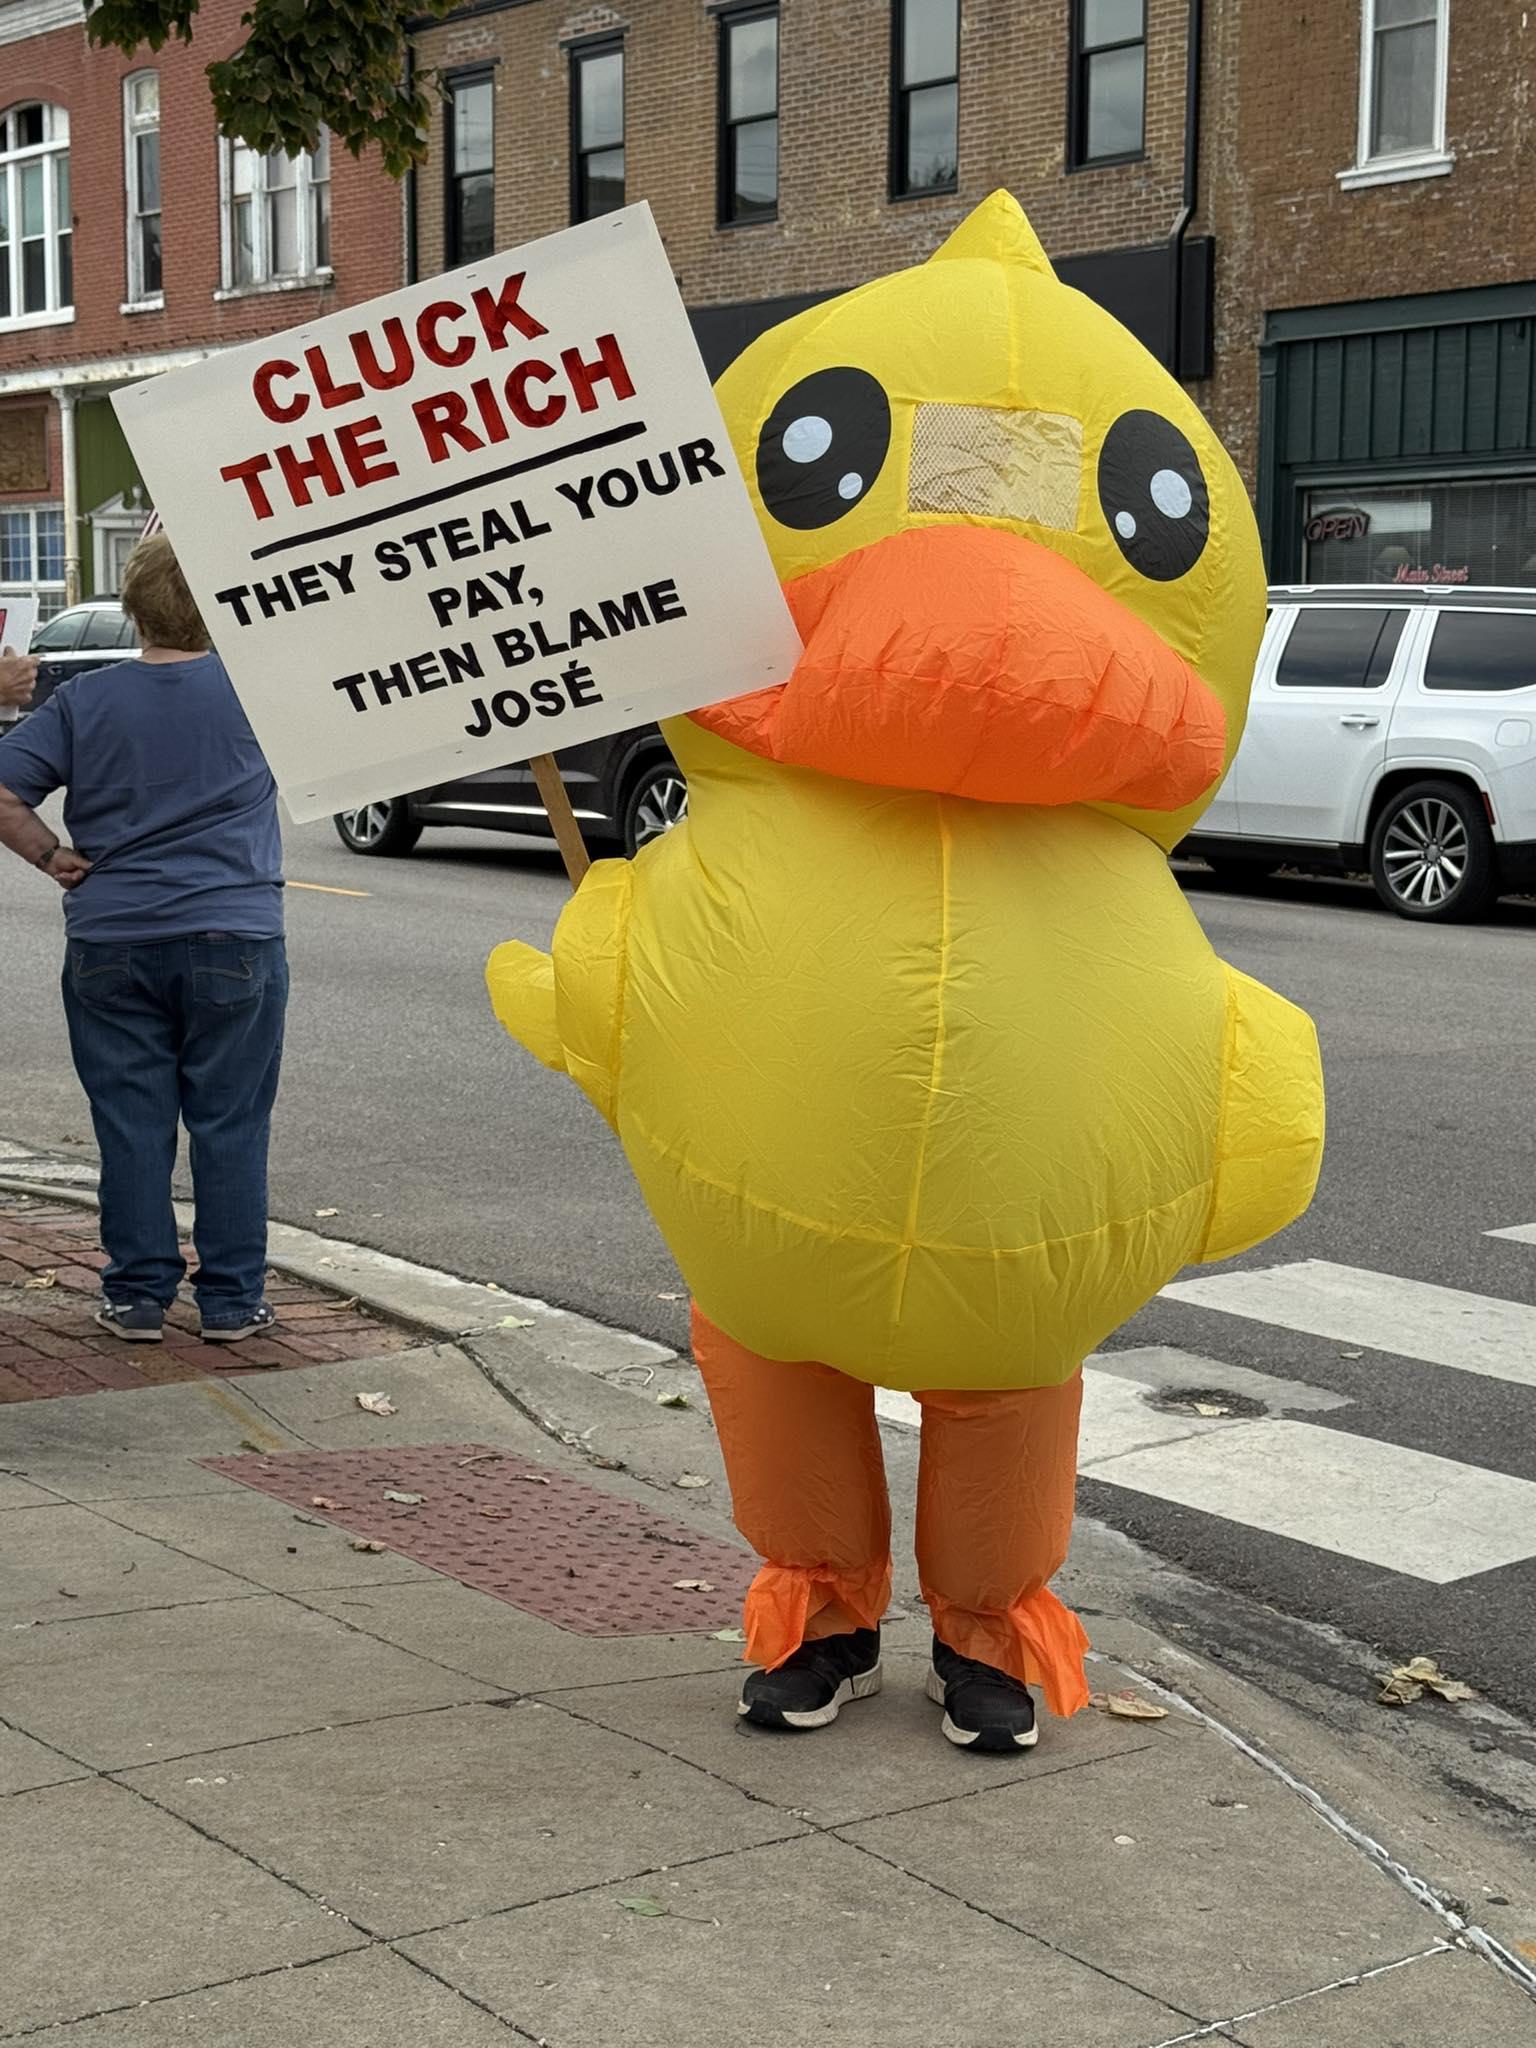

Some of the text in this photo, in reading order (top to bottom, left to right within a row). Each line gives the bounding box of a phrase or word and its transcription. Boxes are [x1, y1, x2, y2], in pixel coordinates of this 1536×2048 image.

[253, 271, 550, 424] CLUCK
[219, 333, 637, 521] THE RICH
[214, 437, 726, 628] THEY STEAL YOUR
[1305, 514, 1369, 541] OPEN
[1392, 563, 1469, 583] Main Street
[332, 578, 688, 713] THEN BLAME
[427, 564, 544, 631] PAY,
[464, 659, 604, 738] JOSÉ
